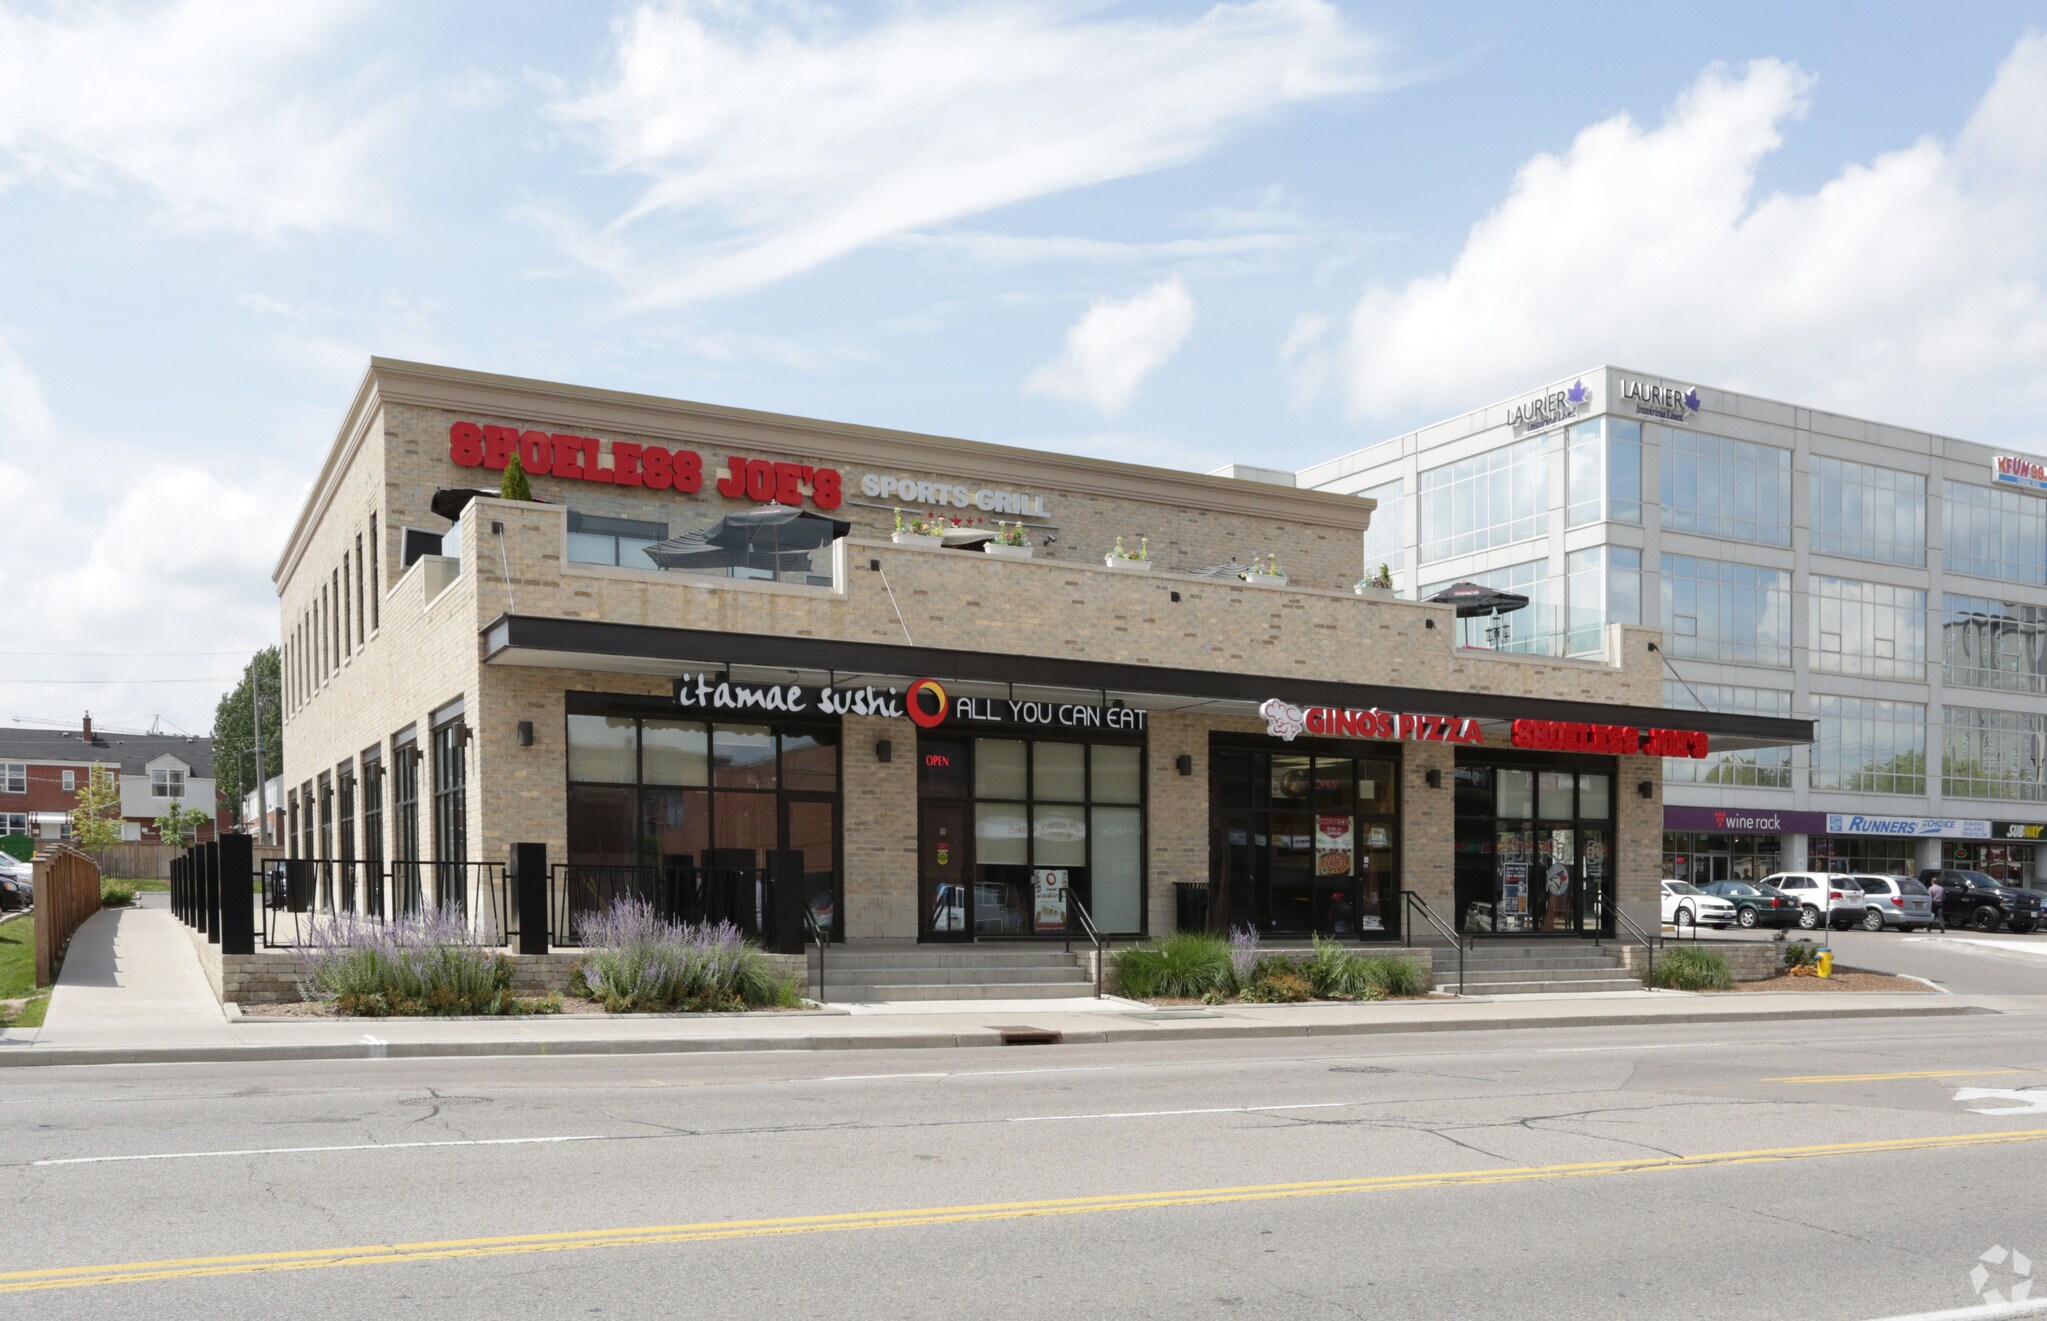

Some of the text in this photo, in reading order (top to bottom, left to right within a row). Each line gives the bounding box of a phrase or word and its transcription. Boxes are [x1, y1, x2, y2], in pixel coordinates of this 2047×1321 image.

[1506, 390, 1567, 426] LAURIER
[1621, 379, 1685, 413] LAURIER
[449, 421, 842, 510] SHOELESS JOE'S
[861, 474, 1051, 518] SPORTS GRILL
[679, 672, 904, 718] itamae sushi
[956, 697, 1148, 730] ALL YOU CAN EAT
[1303, 706, 1485, 744] GINO'S PIZZA
[1511, 718, 1709, 759] SHOELESS JOE'S
[925, 755, 950, 767] OPEN
[1314, 778, 1338, 791] OPEN
[1725, 813, 1781, 830] wine rack
[1848, 815, 1956, 834] RUNNERS' CHOICE
[2006, 823, 2045, 838] SUBWAY
